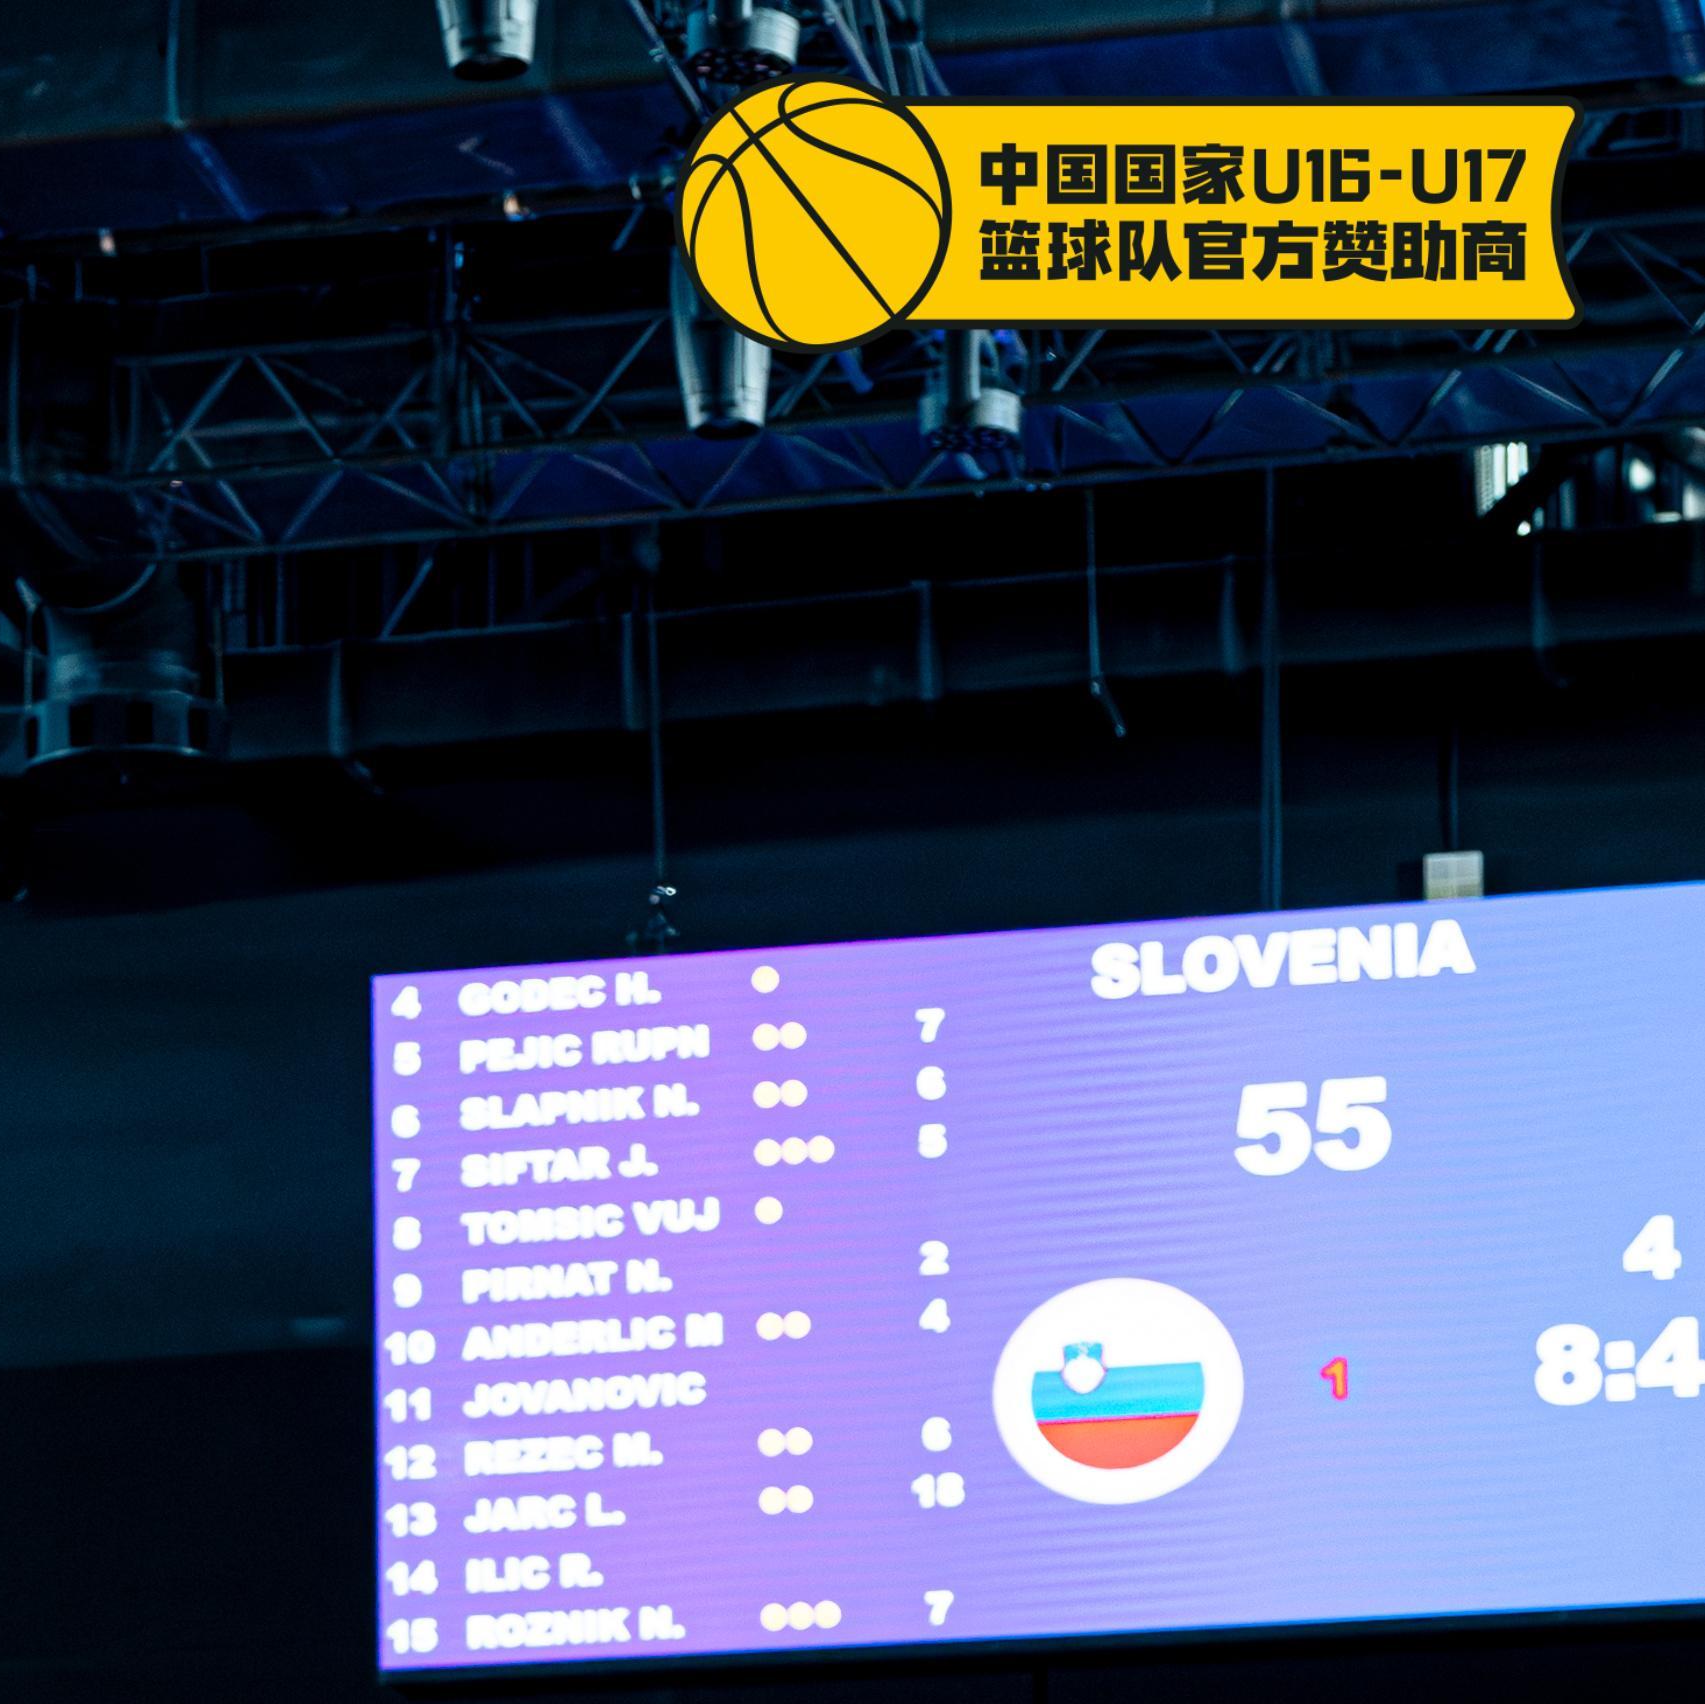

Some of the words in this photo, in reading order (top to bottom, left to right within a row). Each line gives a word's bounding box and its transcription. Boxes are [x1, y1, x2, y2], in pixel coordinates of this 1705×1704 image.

[1090, 919, 1477, 1000] SLOVENIA
[390, 985, 423, 1020] 4
[393, 1041, 422, 1077] 5
[459, 1032, 583, 1074] PEJIC
[914, 1006, 946, 1043] 7
[915, 1065, 947, 1101] 6
[1233, 1075, 1393, 1177] 55
[391, 1157, 422, 1193] 7
[460, 1145, 612, 1189] SIFTAR
[617, 1142, 659, 1178] J.
[632, 1195, 721, 1236] VUJ
[919, 1239, 950, 1276] 2
[1622, 1214, 1683, 1281] 4
[383, 1329, 437, 1366] 10
[918, 1297, 951, 1334] 4
[384, 1386, 432, 1423] 11
[462, 1370, 708, 1419] JOVANOVIC
[1320, 1357, 1349, 1401] 1
[384, 1443, 438, 1481] 12
[384, 1501, 438, 1538] 13
[584, 1491, 627, 1528] L.
[385, 1559, 439, 1597] 14
[386, 1616, 439, 1654] 15
[923, 1589, 955, 1626] 7
